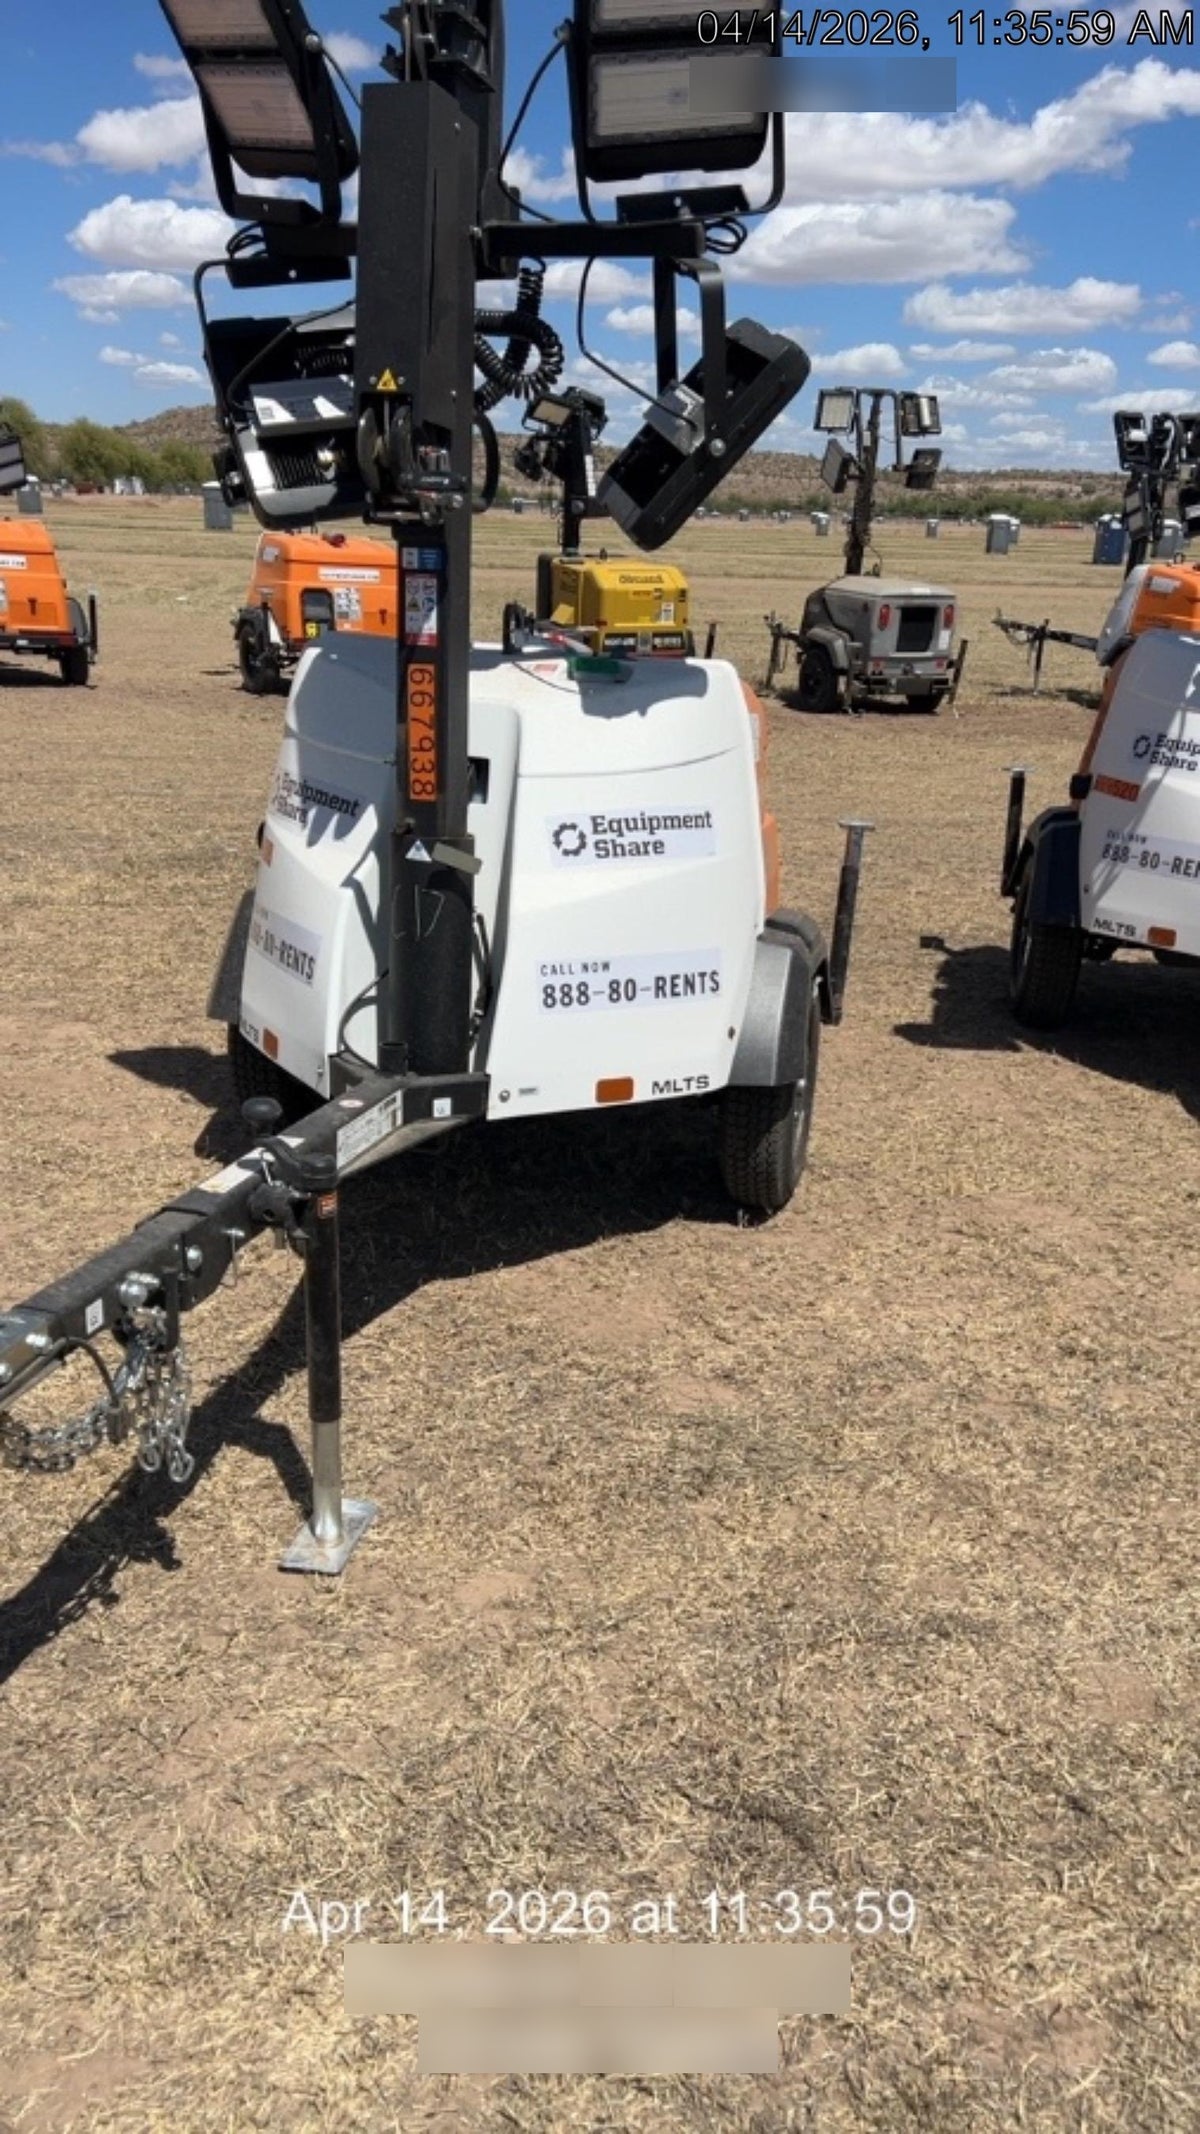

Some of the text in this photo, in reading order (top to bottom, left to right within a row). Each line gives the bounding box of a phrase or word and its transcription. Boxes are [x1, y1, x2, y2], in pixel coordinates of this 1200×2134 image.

[409, 667, 436, 797] 667938
[589, 810, 713, 838] Equipment
[594, 838, 665, 859] Share
[540, 961, 611, 977] CALL NOW
[542, 970, 720, 1009] 888-80-RENTS
[651, 1075, 710, 1095] MLTS
